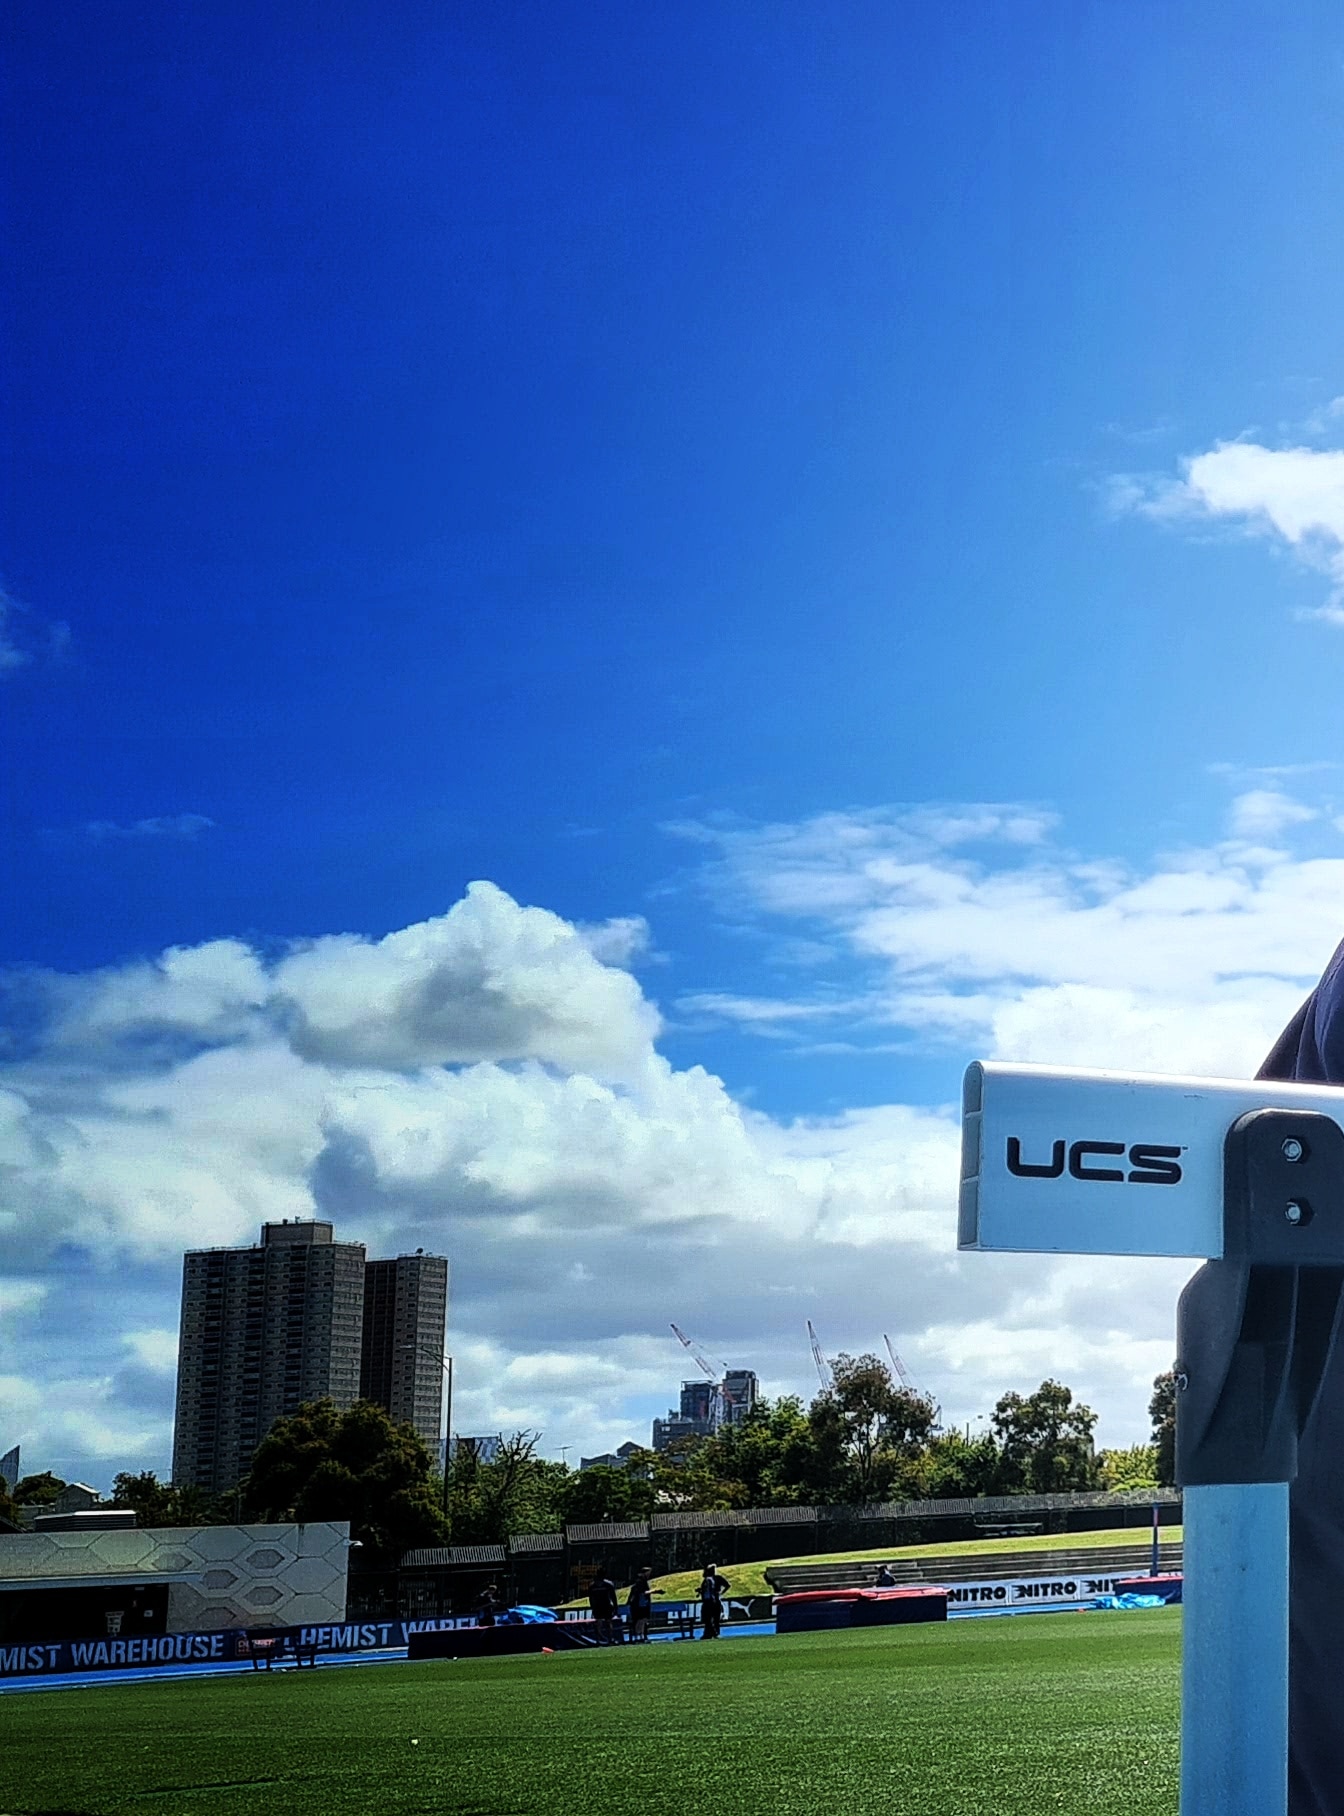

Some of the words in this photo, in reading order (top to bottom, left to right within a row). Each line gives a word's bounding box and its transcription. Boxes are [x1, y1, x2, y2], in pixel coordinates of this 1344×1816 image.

[1007, 1137, 1183, 1185] UCS
[949, 1586, 1007, 1602] NITRO
[1012, 1581, 1077, 1598] NITRO
[71, 1635, 224, 1667] WAREHOUSE
